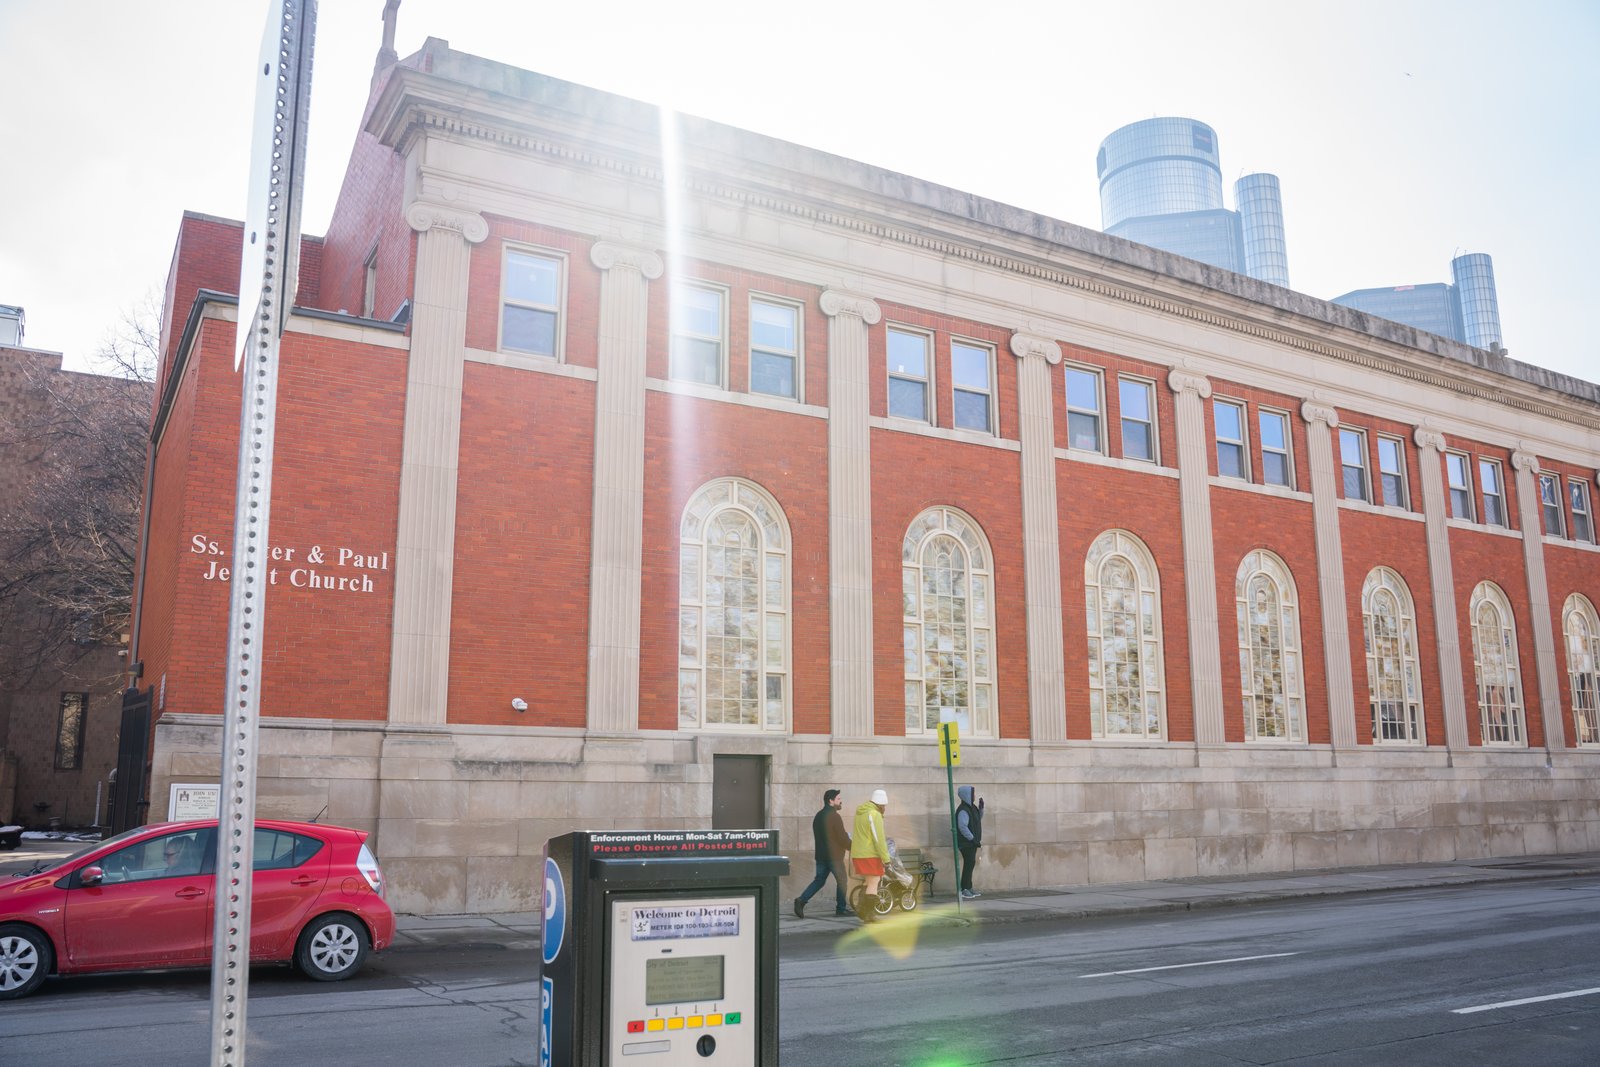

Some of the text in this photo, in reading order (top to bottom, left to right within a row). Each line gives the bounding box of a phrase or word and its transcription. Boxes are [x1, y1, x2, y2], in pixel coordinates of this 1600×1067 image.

[191, 534, 225, 556] Ss.
[307, 545, 325, 564] &
[337, 547, 388, 570] Paul
[203, 561, 374, 593] Jet Church
[590, 831, 769, 843] Enforcement Hours: Mon-Sat 7am-10pm
[593, 841, 767, 853] Please Observe All Posted Signs!
[634, 909, 684, 920] Welcome
[685, 910, 696, 919] to
[699, 907, 736, 918] Detroit
